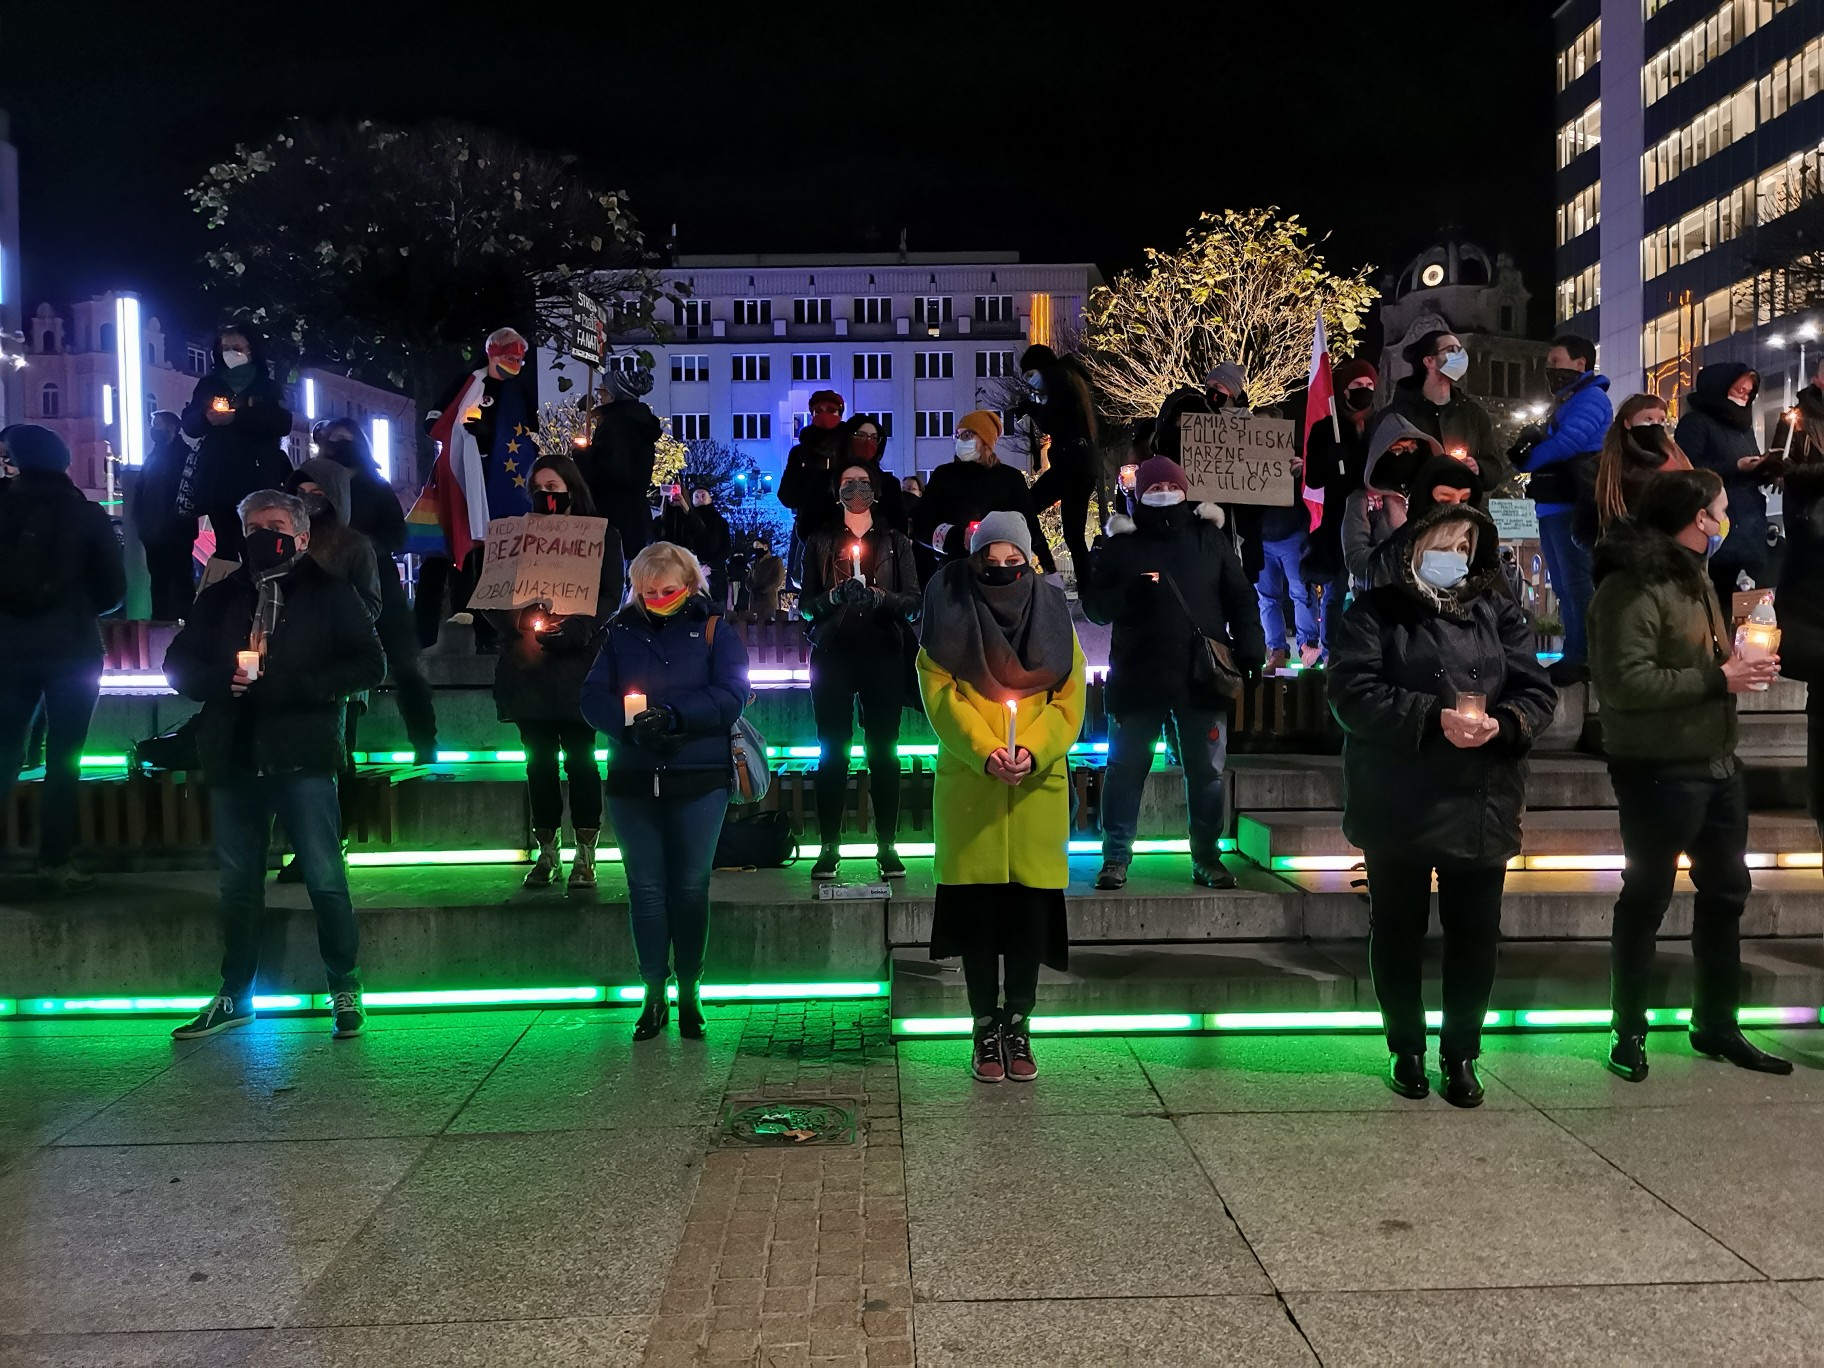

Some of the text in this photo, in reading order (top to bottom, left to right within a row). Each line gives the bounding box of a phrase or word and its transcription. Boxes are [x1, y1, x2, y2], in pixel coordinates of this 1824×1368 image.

[1182, 414, 1251, 430] ZAMIAST
[1182, 427, 1295, 449] TULIĆ PIESKA
[1182, 445, 1245, 462] MARZNĘ
[1183, 459, 1283, 478] PRZEZ WAS
[1218, 475, 1269, 491] ULICY
[487, 534, 603, 563] BEZPRAWIEM
